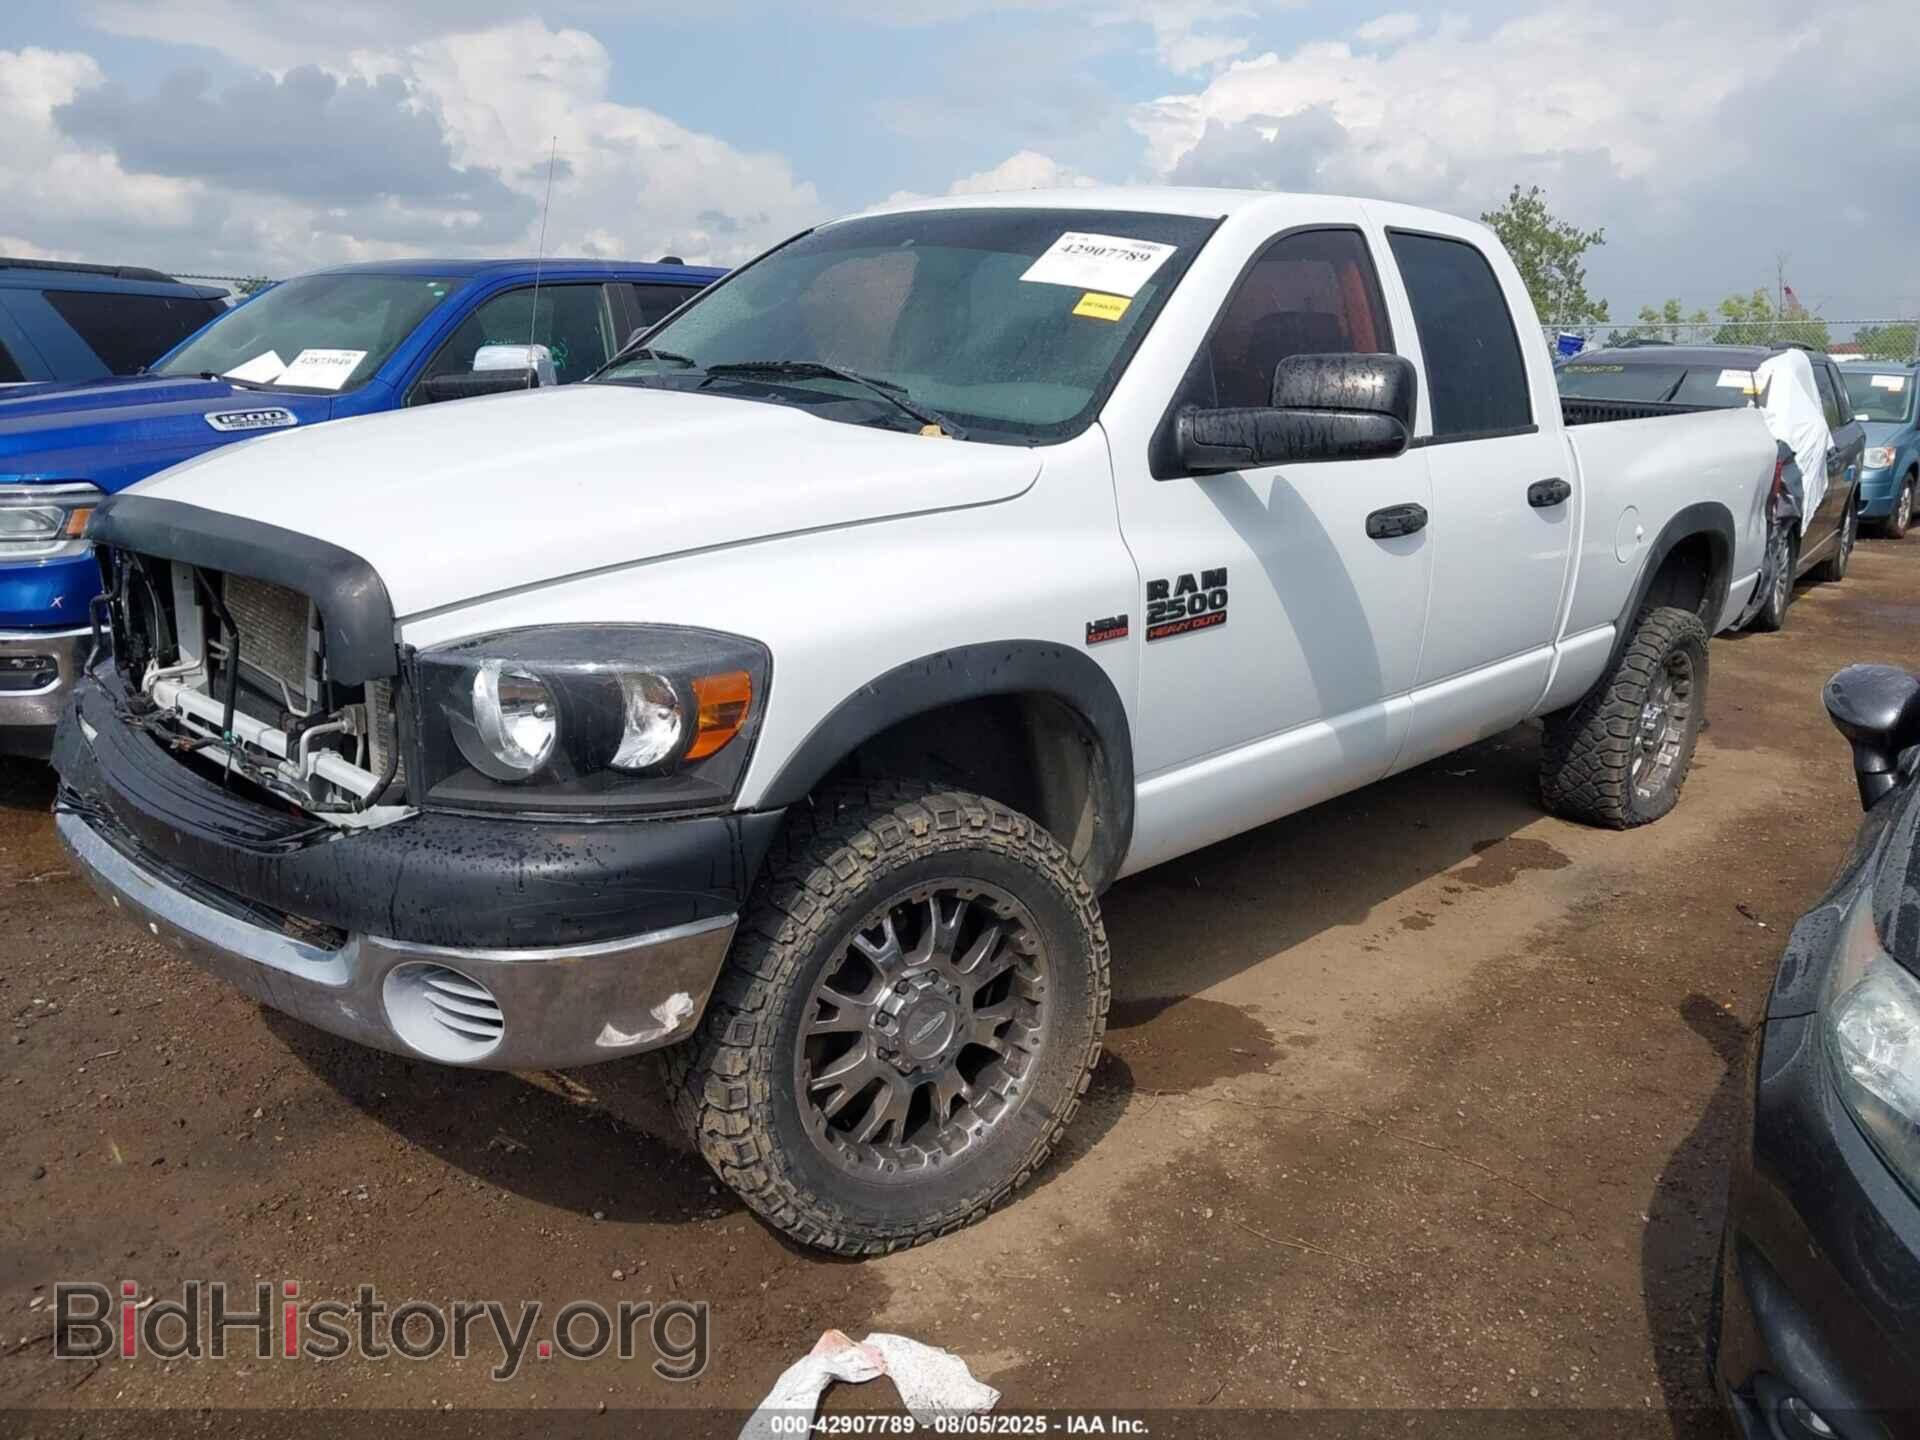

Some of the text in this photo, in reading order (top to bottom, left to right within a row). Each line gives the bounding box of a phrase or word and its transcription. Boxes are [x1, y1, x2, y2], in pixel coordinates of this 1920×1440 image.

[1061, 244, 1152, 262] 42907789
[221, 411, 282, 424] 1500
[1146, 567, 1228, 602] RAM
[1146, 588, 1229, 626] 2500
[1086, 614, 1128, 633] HEMI
[1149, 612, 1226, 639] HEAVY DUTY
